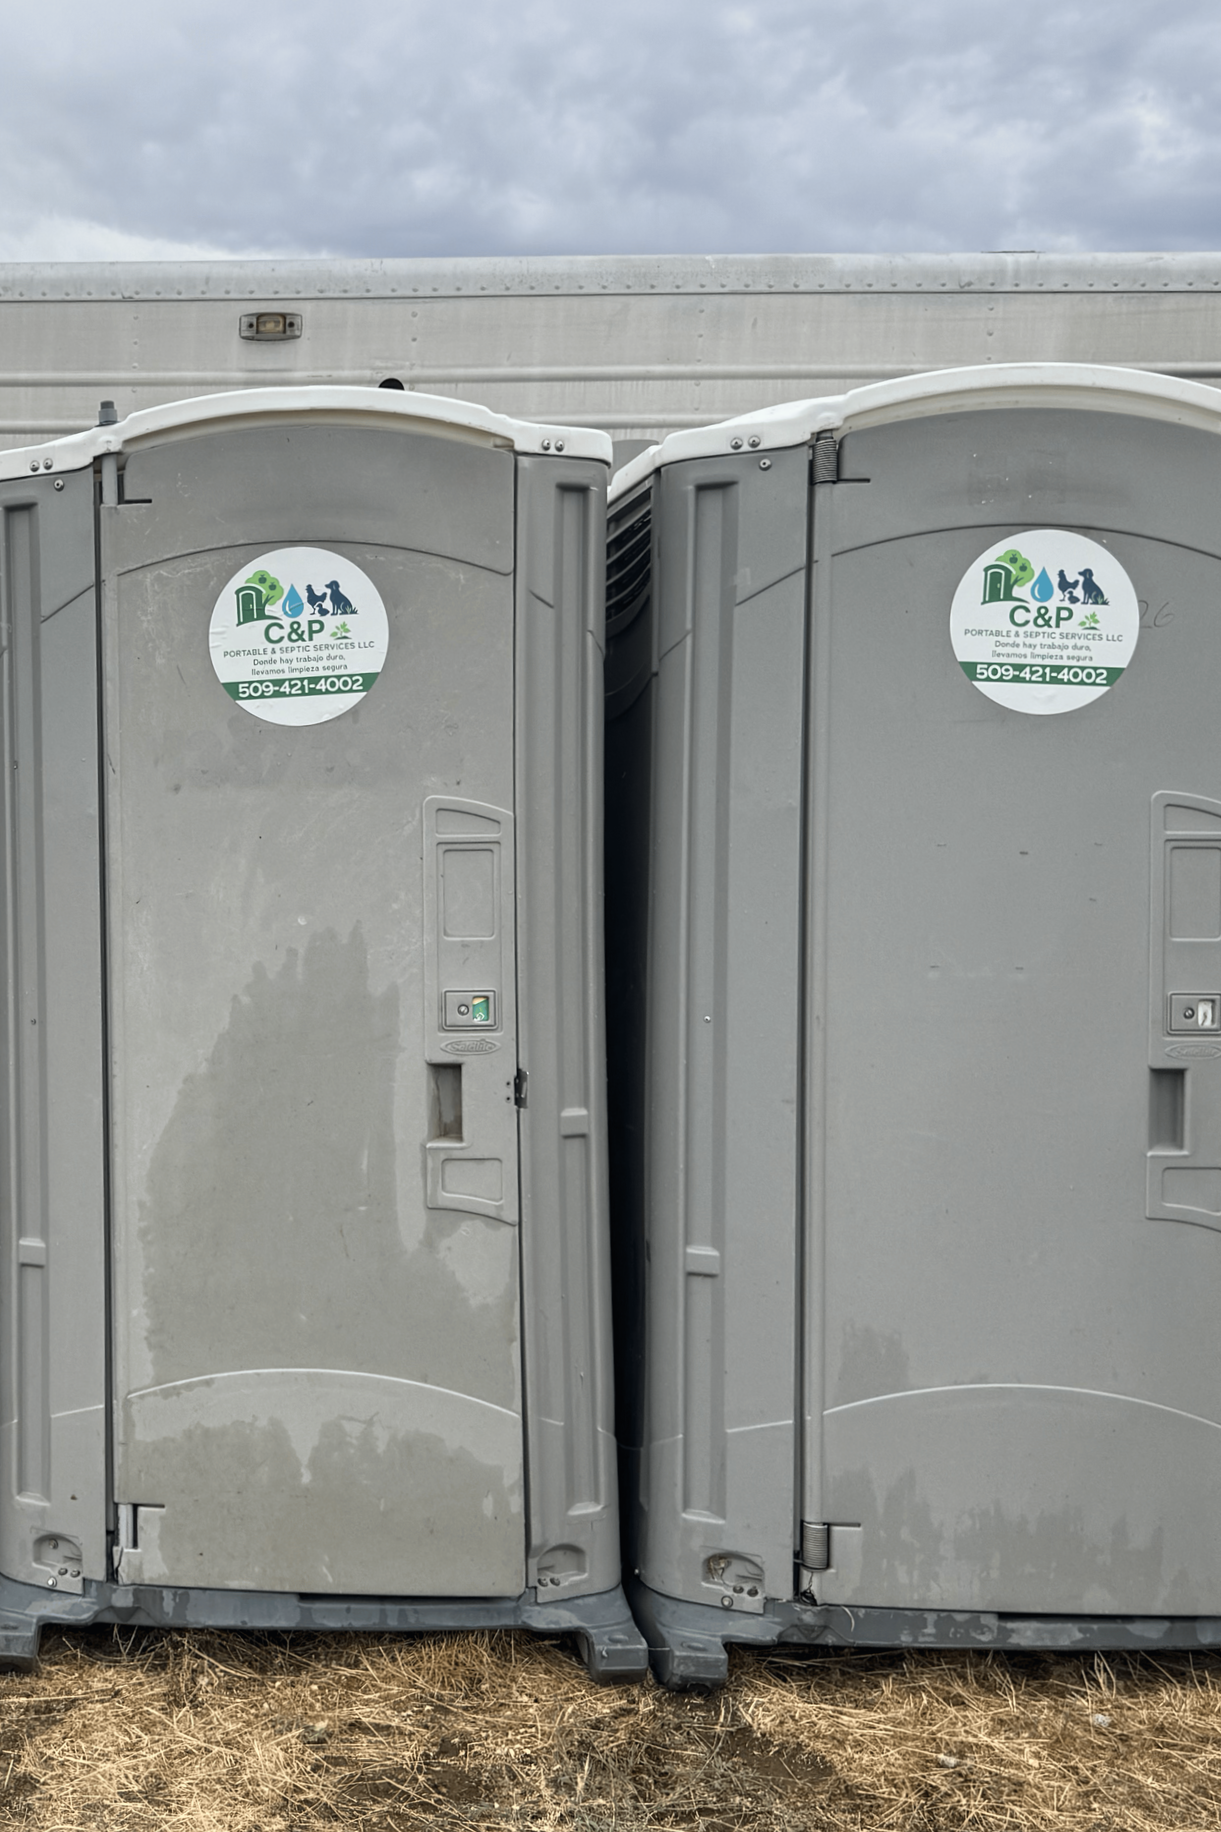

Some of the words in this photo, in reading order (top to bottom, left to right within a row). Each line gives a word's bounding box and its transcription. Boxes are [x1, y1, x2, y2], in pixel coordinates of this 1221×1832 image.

[1009, 605, 1073, 628] C&P
[264, 620, 325, 644] C&P
[964, 629, 1012, 638] PORTABLE
[1014, 630, 1020, 638] &
[1023, 631, 1056, 640] SEPTIC
[1059, 632, 1103, 641] SERVICES
[1106, 634, 1123, 642] LLC
[223, 648, 268, 658] PORTABLE
[280, 645, 310, 654] SEPTIC
[313, 642, 355, 651] SERVICES
[358, 641, 375, 649] LLC
[995, 640, 1020, 649] Donde
[1023, 642, 1037, 650] hay
[1040, 642, 1069, 651] trabajo
[1072, 643, 1091, 652] duro,
[253, 658, 277, 666] Donde
[280, 657, 293, 665] hay
[296, 655, 323, 663] trabajo
[326, 653, 345, 661] duro,
[992, 650, 1027, 659] llevamos
[1030, 652, 1063, 661] limpieza
[1066, 654, 1093, 662] segura
[252, 667, 285, 676] llevamos
[288, 666, 319, 675] limpieza
[322, 664, 348, 672] segura
[976, 664, 1107, 684] 509-421-4002
[238, 676, 363, 698] 509-421-4002
